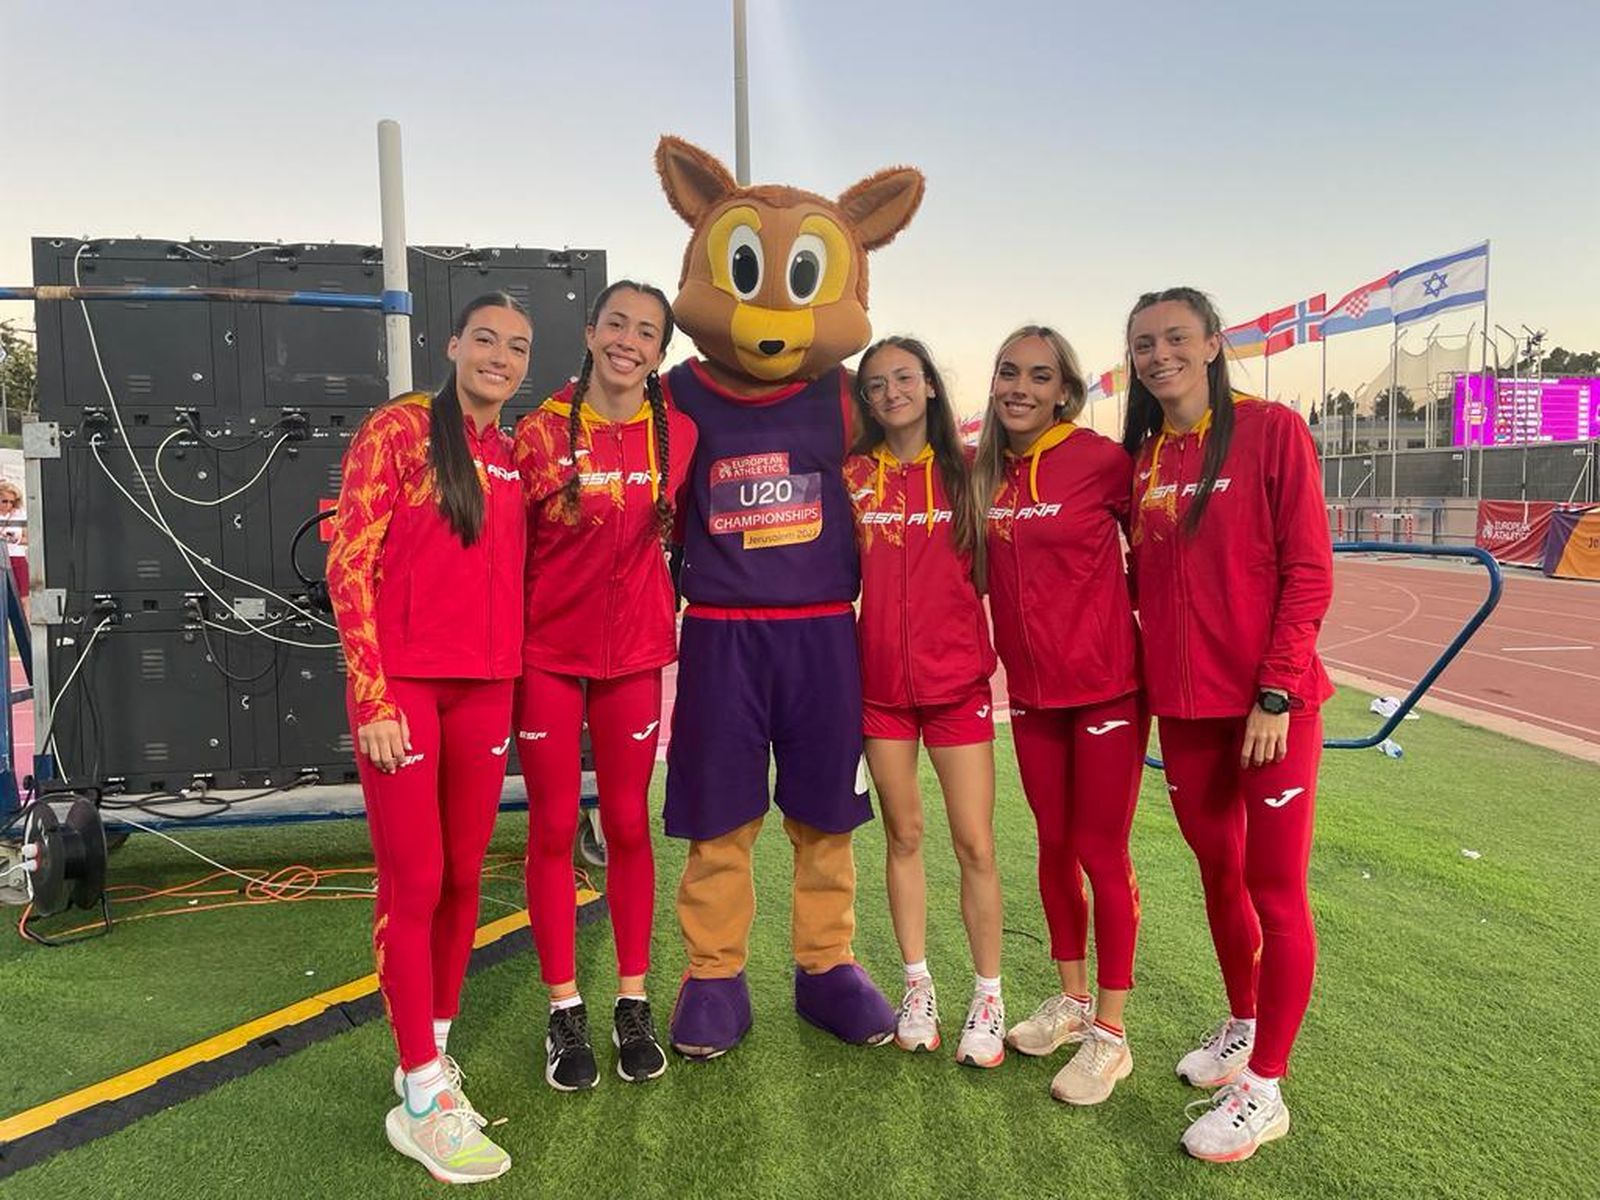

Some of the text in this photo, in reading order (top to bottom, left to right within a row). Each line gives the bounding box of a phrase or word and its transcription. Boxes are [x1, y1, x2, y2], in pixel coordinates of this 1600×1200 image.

[732, 455, 783, 469] EUROPEAN
[734, 463, 785, 478] ATHLETICS
[740, 479, 792, 507] U20
[714, 507, 819, 530] CHAMPIONSHIPS
